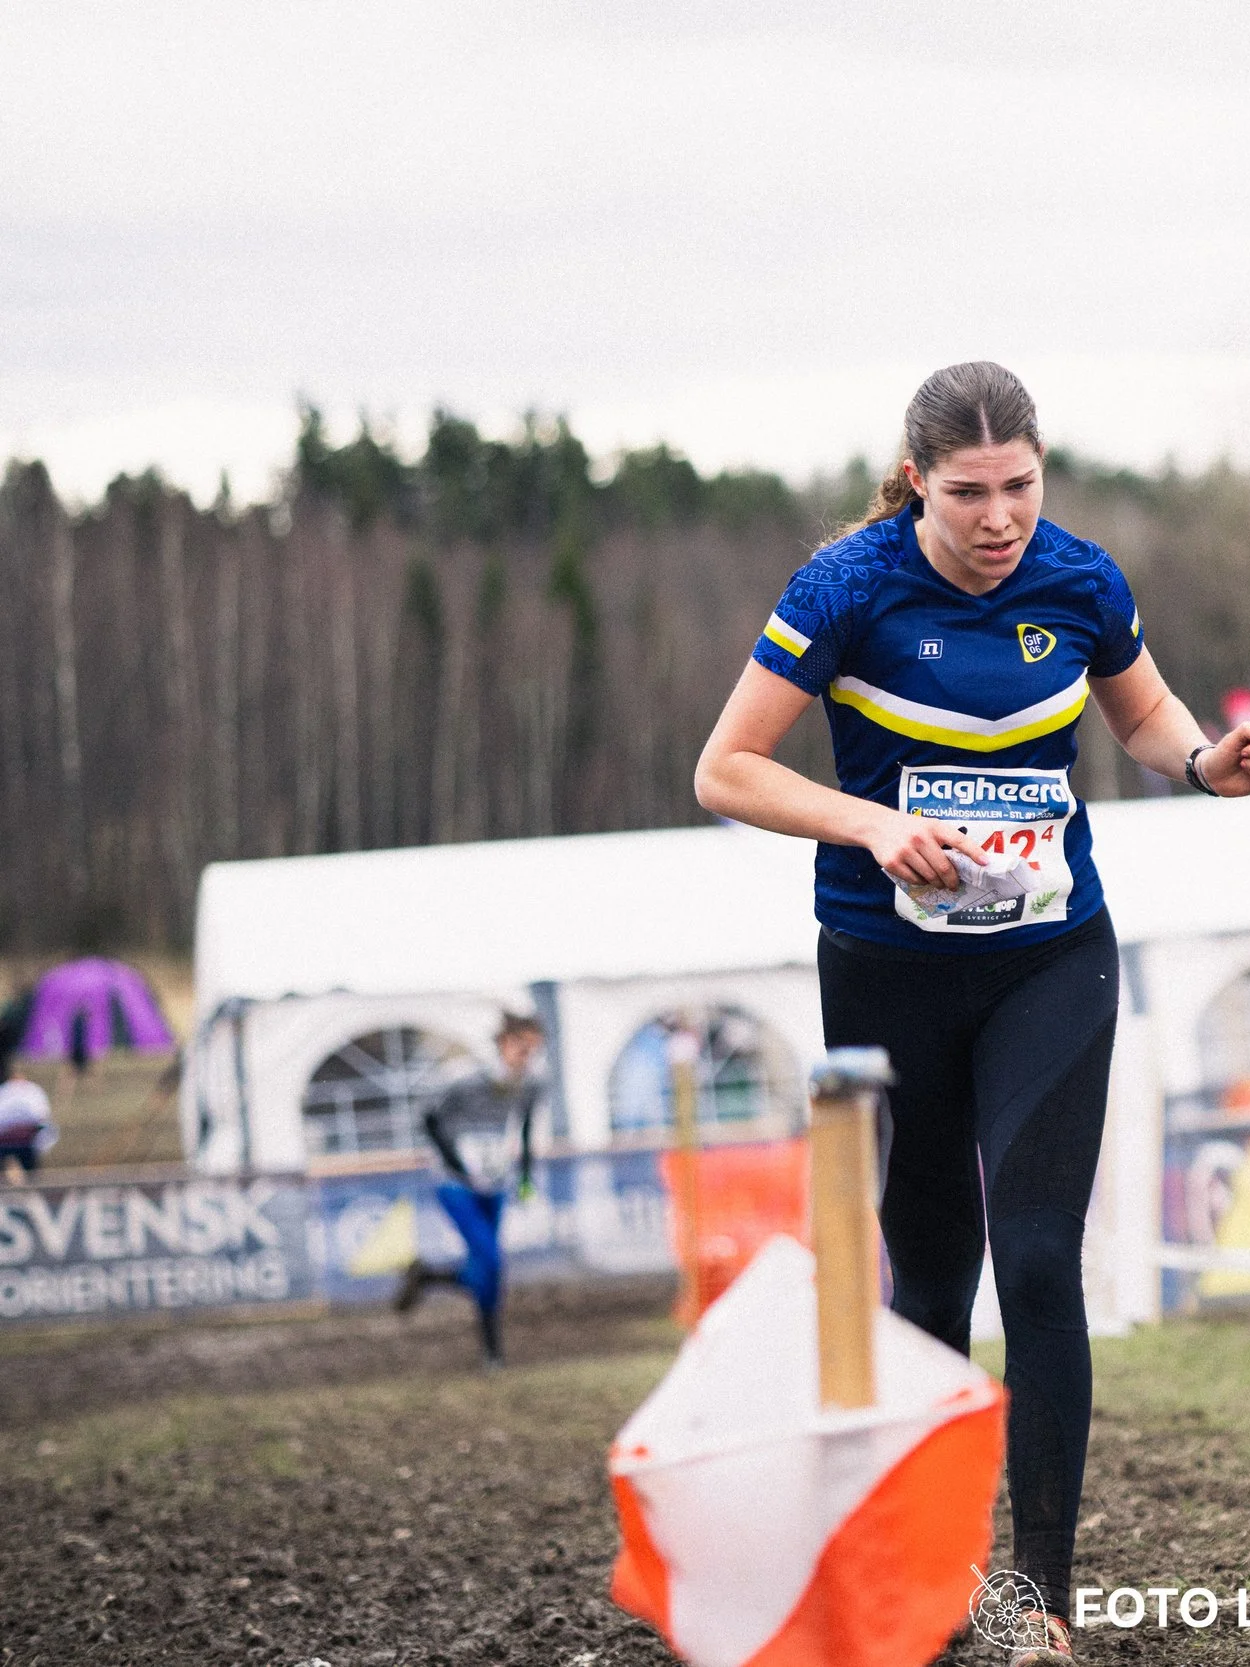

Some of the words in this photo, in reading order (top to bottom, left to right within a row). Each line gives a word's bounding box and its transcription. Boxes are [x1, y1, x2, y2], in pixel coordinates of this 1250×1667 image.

[1024, 633, 1043, 646] GIF
[1029, 645, 1042, 654] 06
[908, 775, 1068, 804] bagheera
[923, 807, 1002, 819] KOLMÅRDSKAVLEN
[1009, 811, 1024, 820] STL
[0, 1180, 278, 1265] SVENSK
[0, 1250, 289, 1318] ORIENTERING
